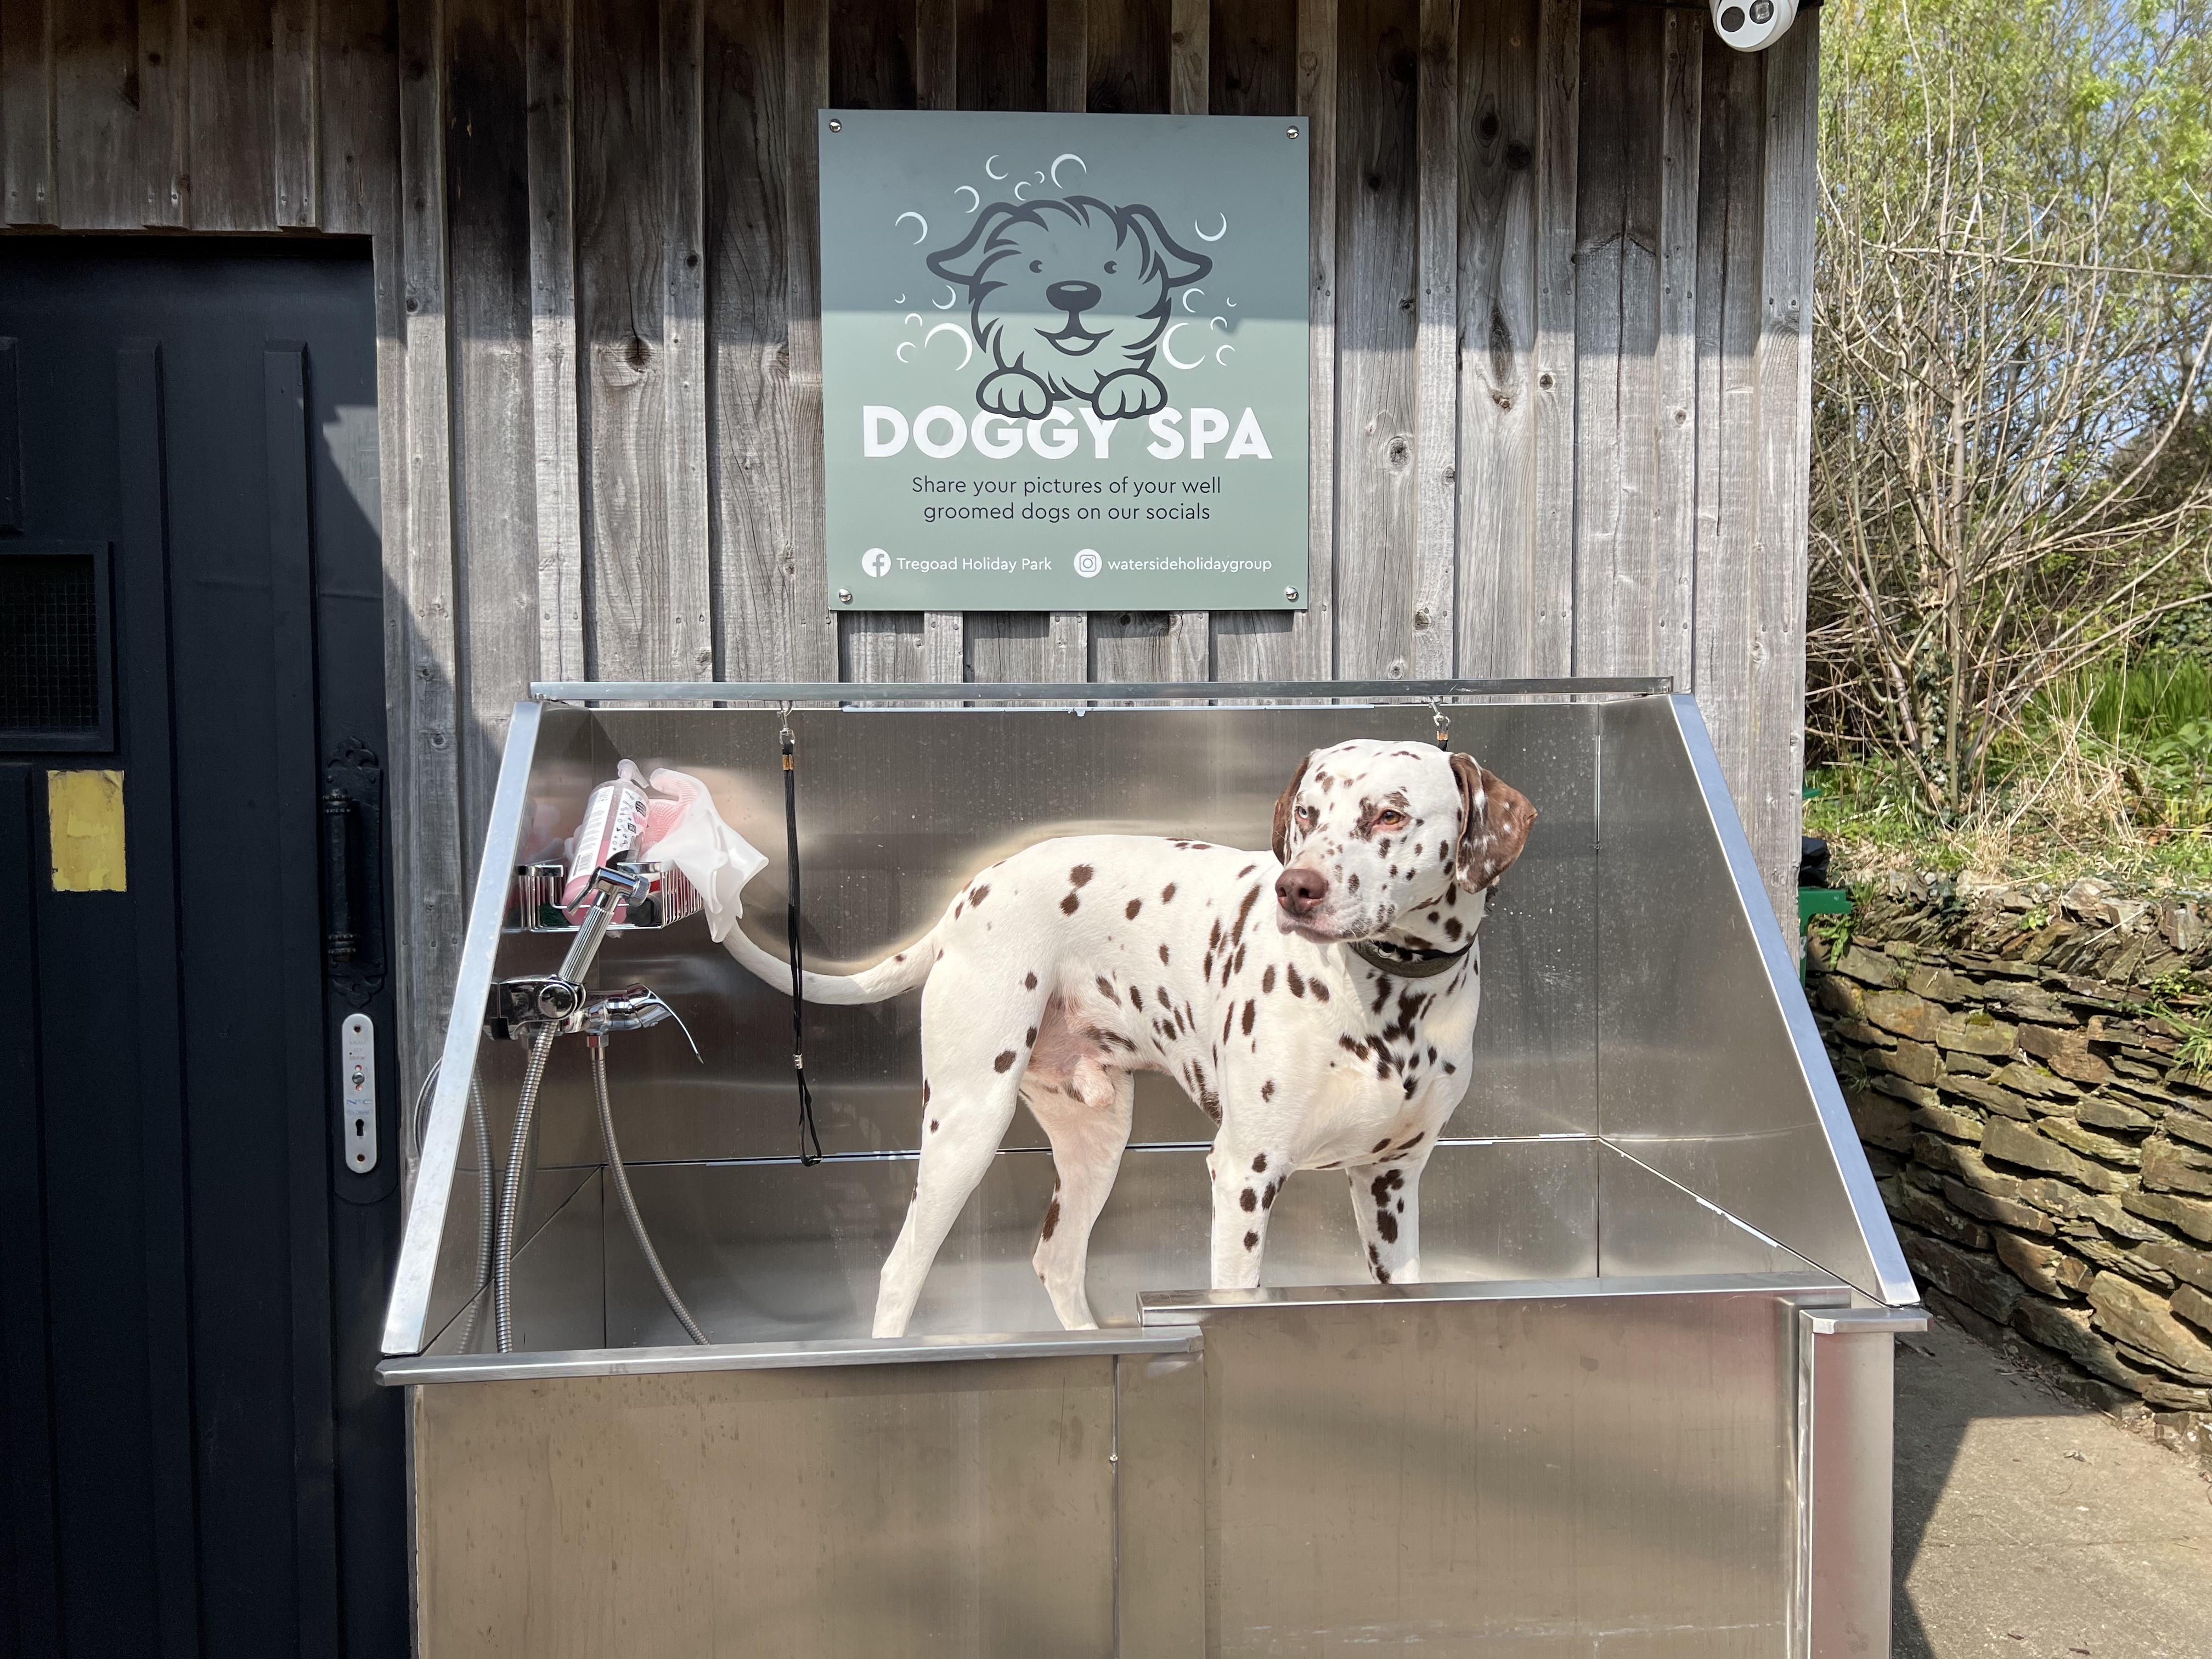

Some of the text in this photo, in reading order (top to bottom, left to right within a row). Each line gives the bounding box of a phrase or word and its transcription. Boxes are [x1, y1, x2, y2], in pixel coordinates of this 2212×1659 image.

[863, 405, 1273, 460] DOGGY SPA
[912, 475, 1221, 498] Share your pictures of your well
[924, 501, 1210, 523] groomed dogs on our socials
[896, 556, 1053, 573] Tregoad Holiday Park
[1107, 556, 1273, 573] watersideholidaygroup
